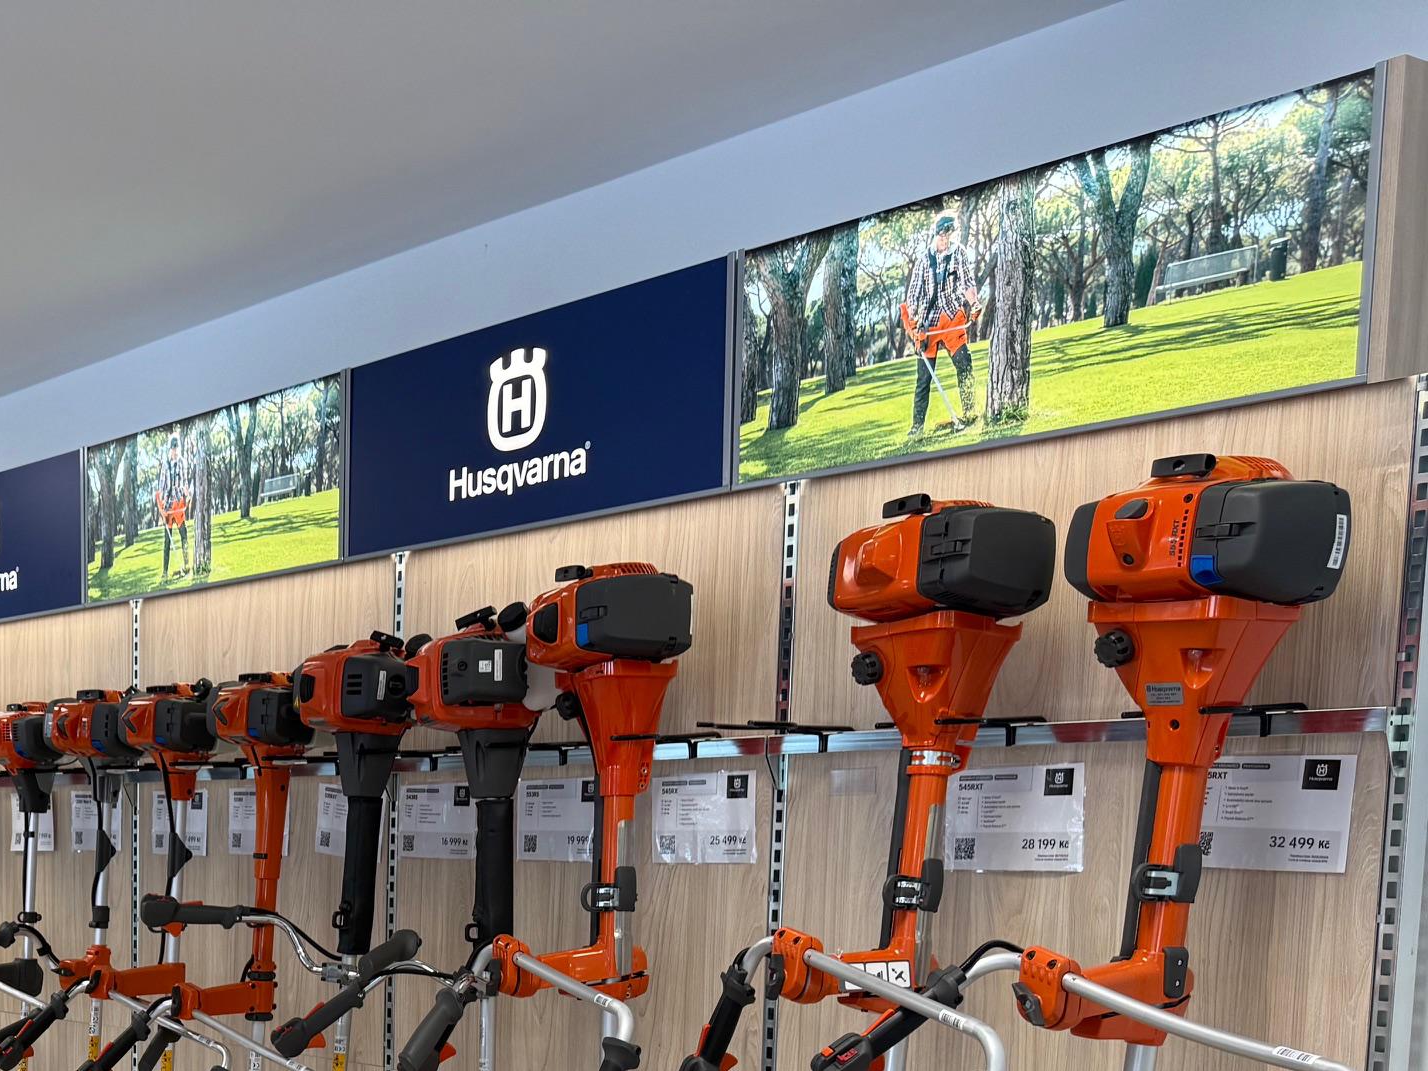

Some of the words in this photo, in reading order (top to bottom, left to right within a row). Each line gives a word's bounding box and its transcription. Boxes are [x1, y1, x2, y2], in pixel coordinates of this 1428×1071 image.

[449, 447, 588, 502] Husqvarna
[450, 837, 462, 846] 999
[709, 835, 720, 846] 25
[722, 835, 737, 845] 499
[1022, 839, 1035, 850] 28
[1038, 839, 1056, 850] 199
[1059, 840, 1069, 849] Kč
[1269, 835, 1285, 849] 32
[1289, 836, 1314, 849] 499
[1318, 839, 1330, 849] Kč
